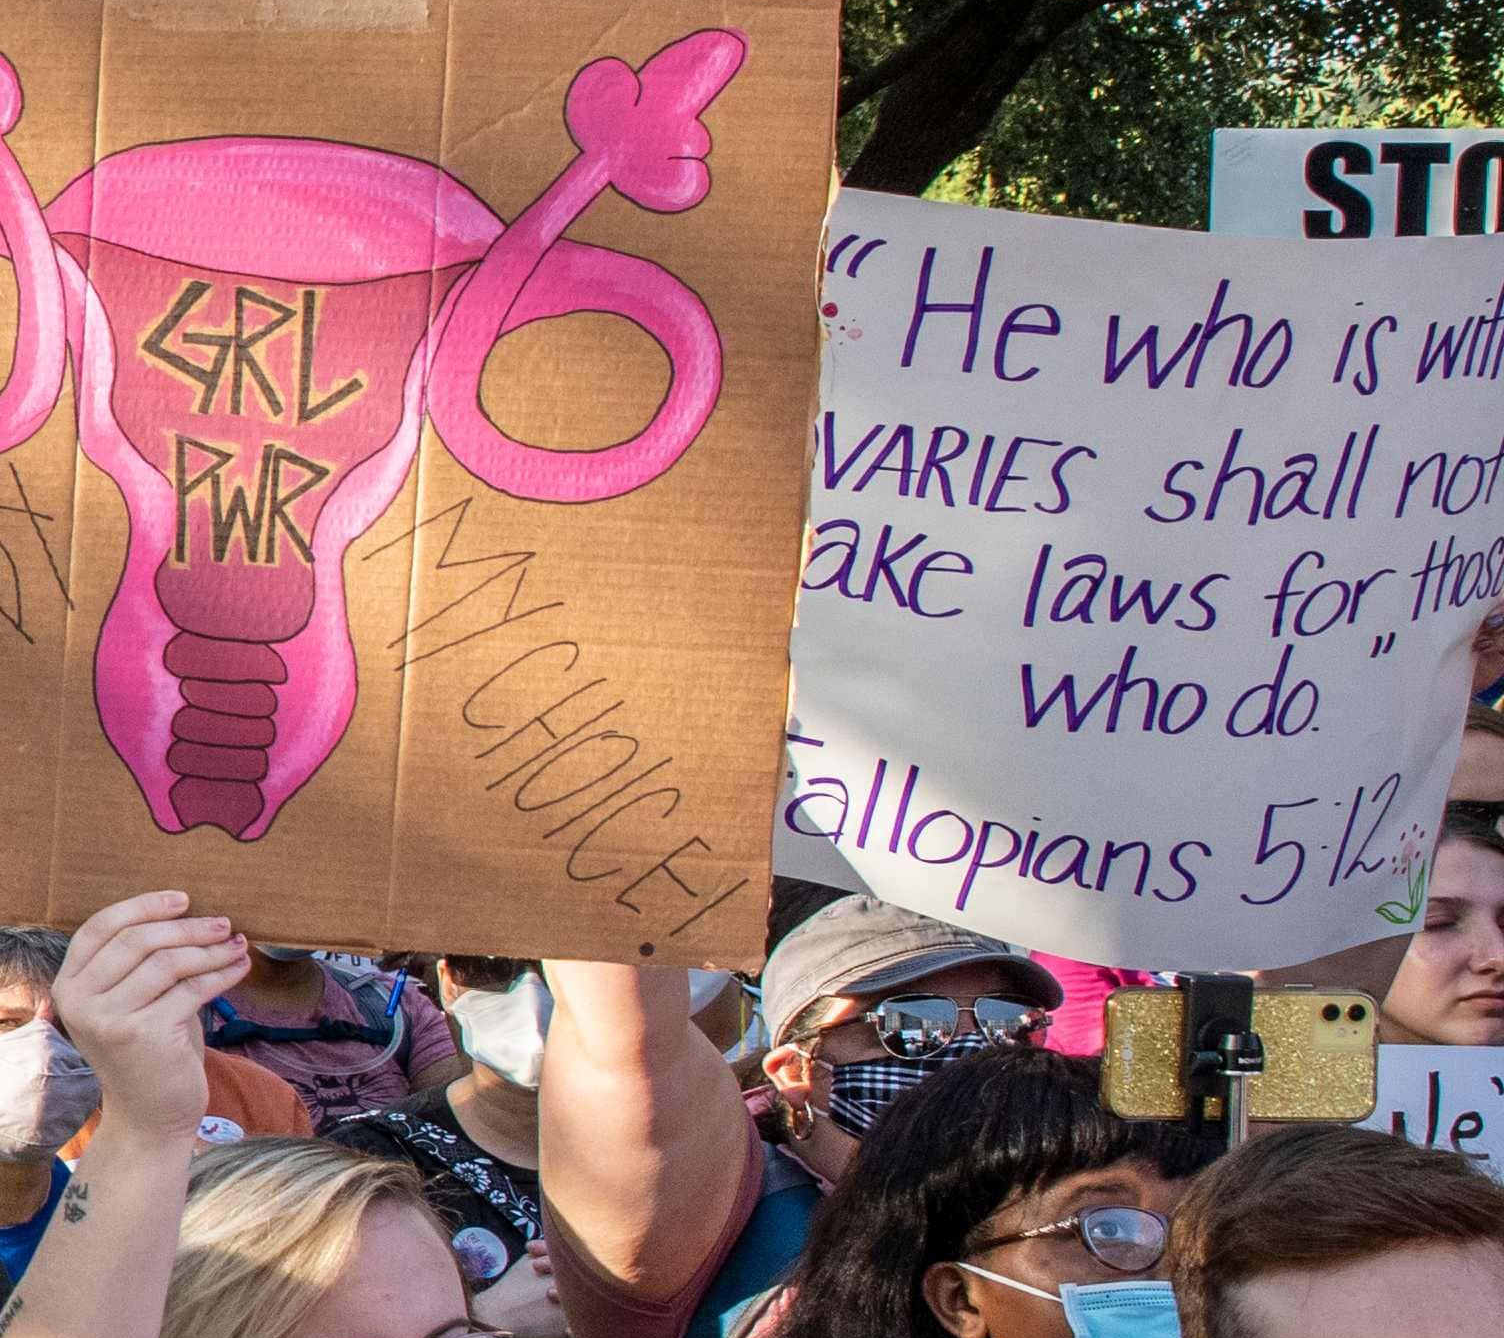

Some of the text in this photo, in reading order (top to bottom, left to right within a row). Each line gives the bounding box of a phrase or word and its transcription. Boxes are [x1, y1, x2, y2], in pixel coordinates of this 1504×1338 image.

[140, 279, 366, 425] GRL
[1103, 278, 1294, 390] who
[1333, 301, 1398, 396] is
[169, 431, 334, 569] PWR
[812, 410, 1097, 517] VARIES
[1145, 425, 1379, 527] shall
[361, 497, 565, 672] MY
[800, 516, 974, 619] ake
[1022, 543, 1230, 633] laws
[1263, 548, 1399, 640] for
[1020, 645, 1208, 735] who
